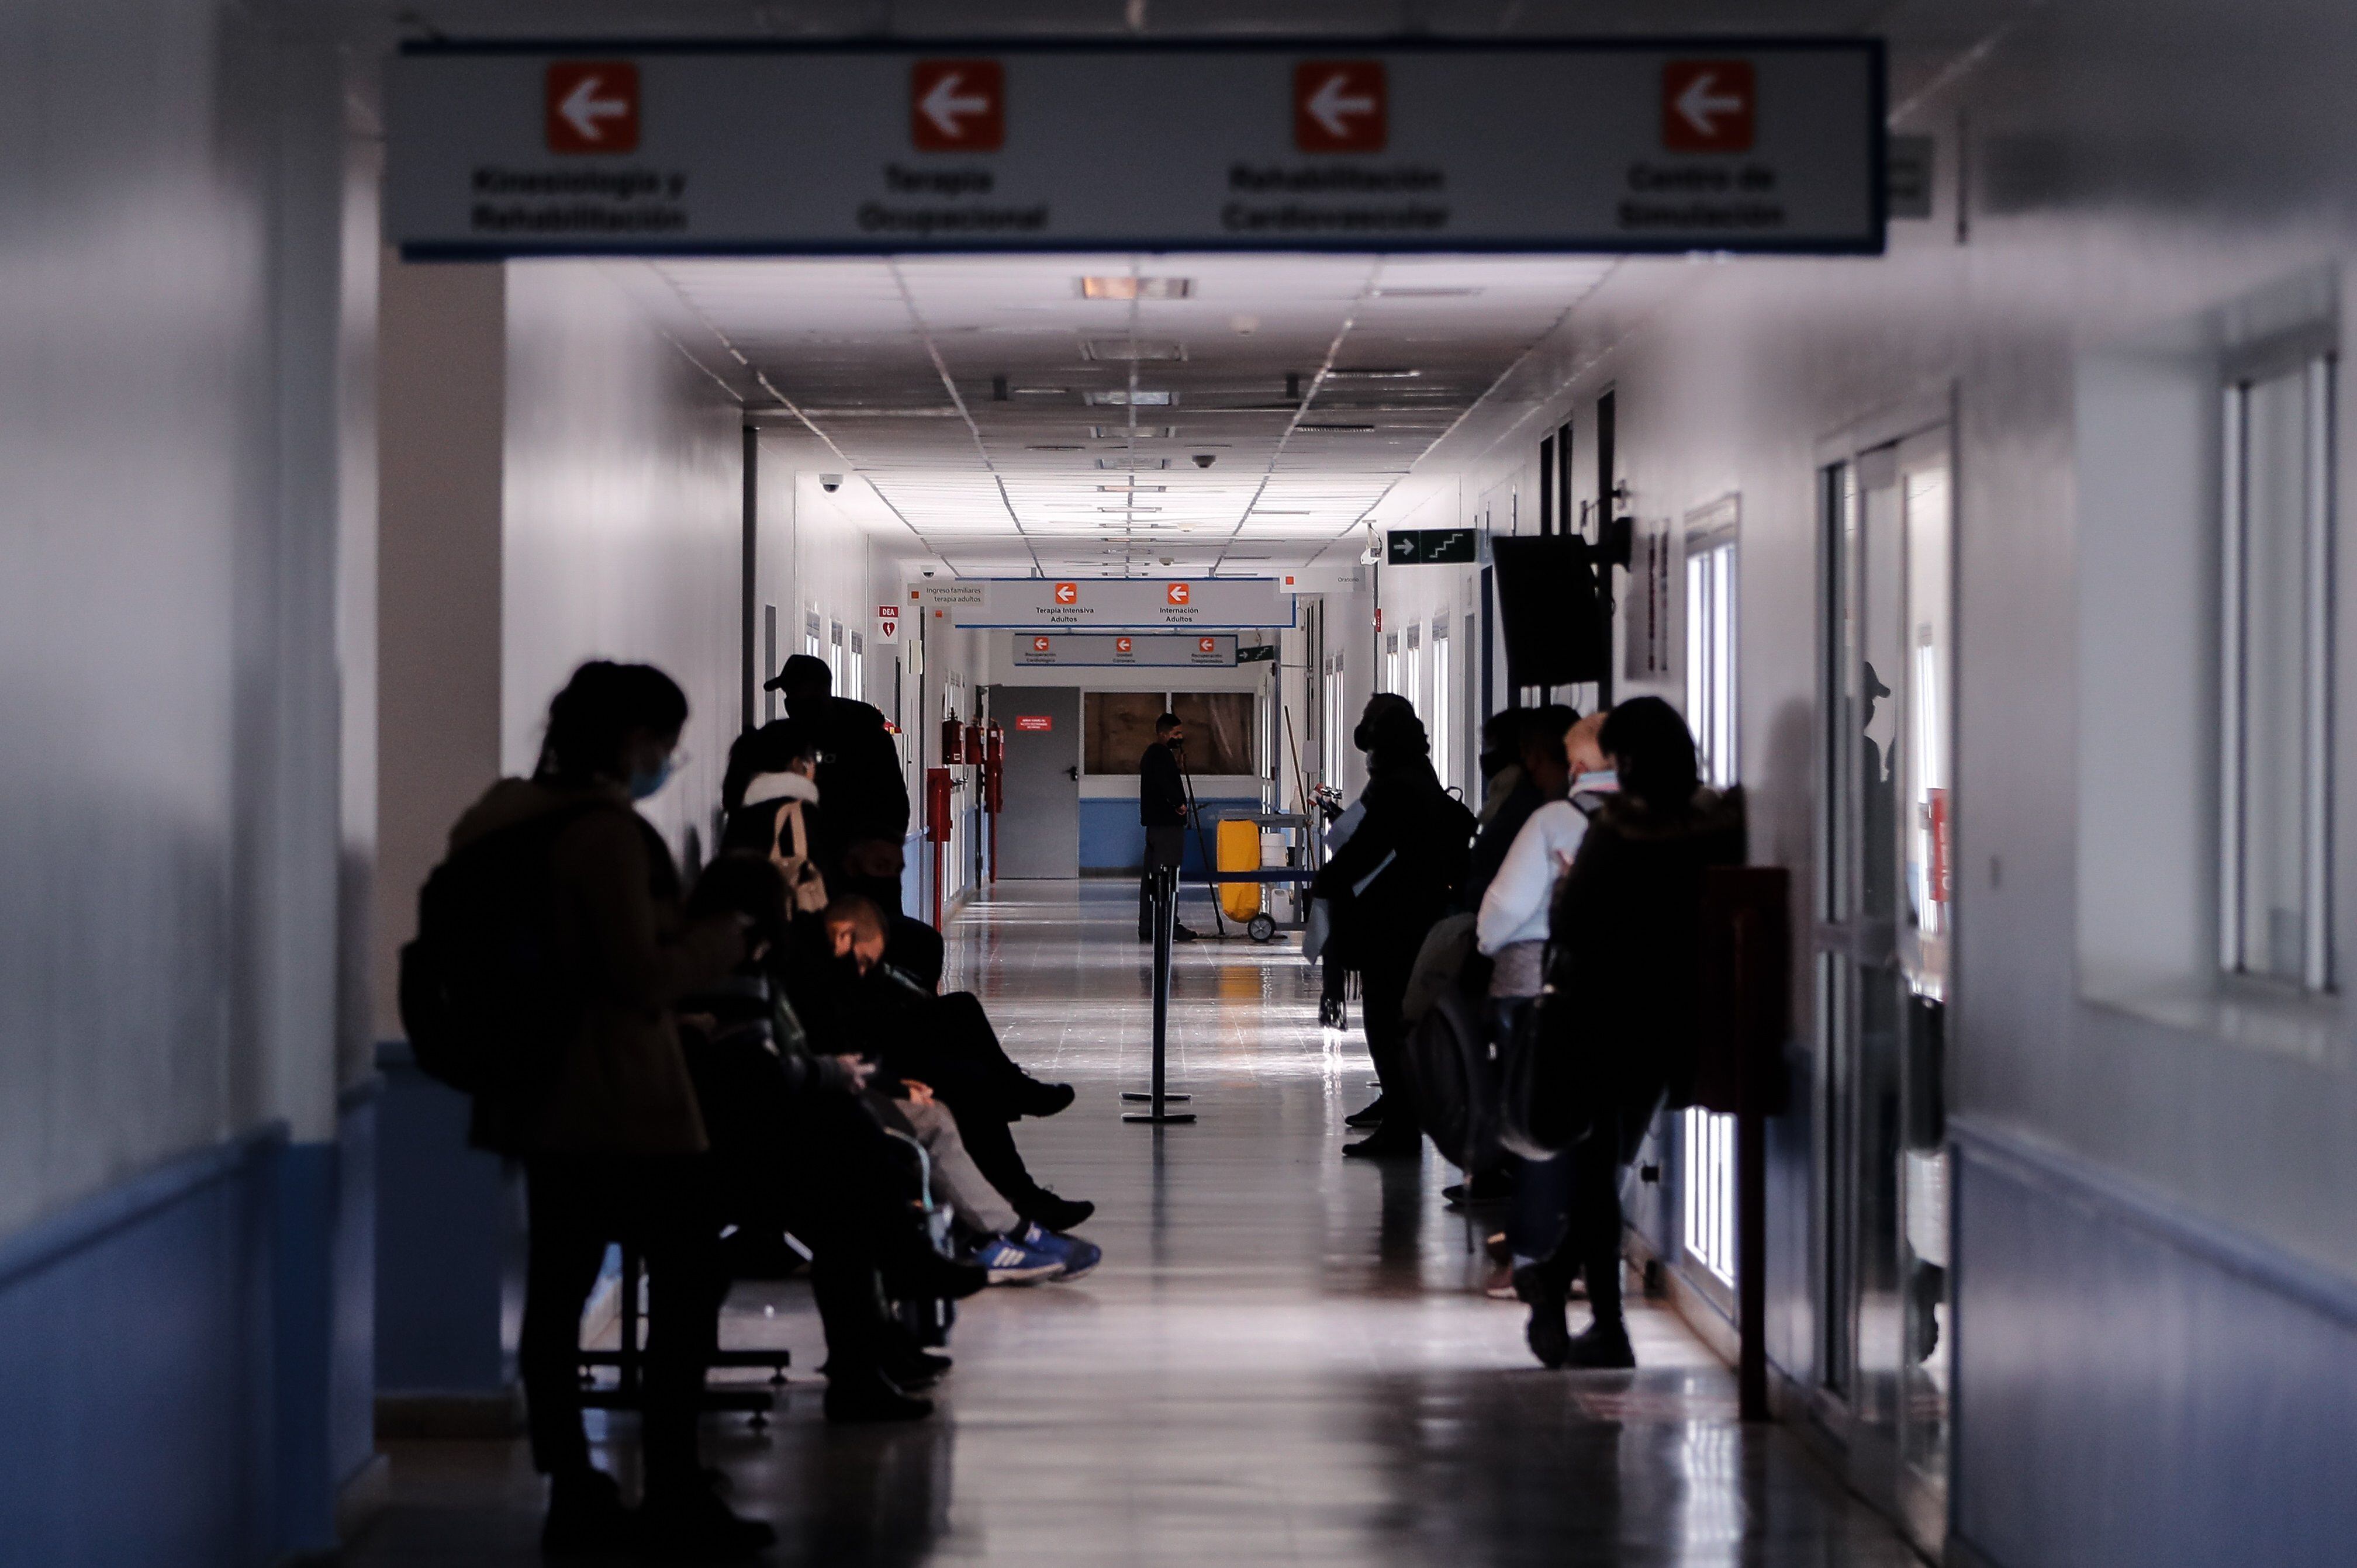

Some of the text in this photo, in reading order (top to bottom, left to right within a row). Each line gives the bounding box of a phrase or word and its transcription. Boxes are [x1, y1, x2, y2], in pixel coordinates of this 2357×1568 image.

[666, 173, 686, 200] y
[884, 164, 993, 198] Terapia
[1228, 165, 1445, 192] Rehabilitación
[1628, 163, 1775, 191] Centro de
[472, 205, 687, 230] Rehabilitación
[858, 202, 1049, 233] Ocupacional
[1221, 202, 1447, 229] Cardiovascular
[1618, 200, 1785, 229] Simulación
